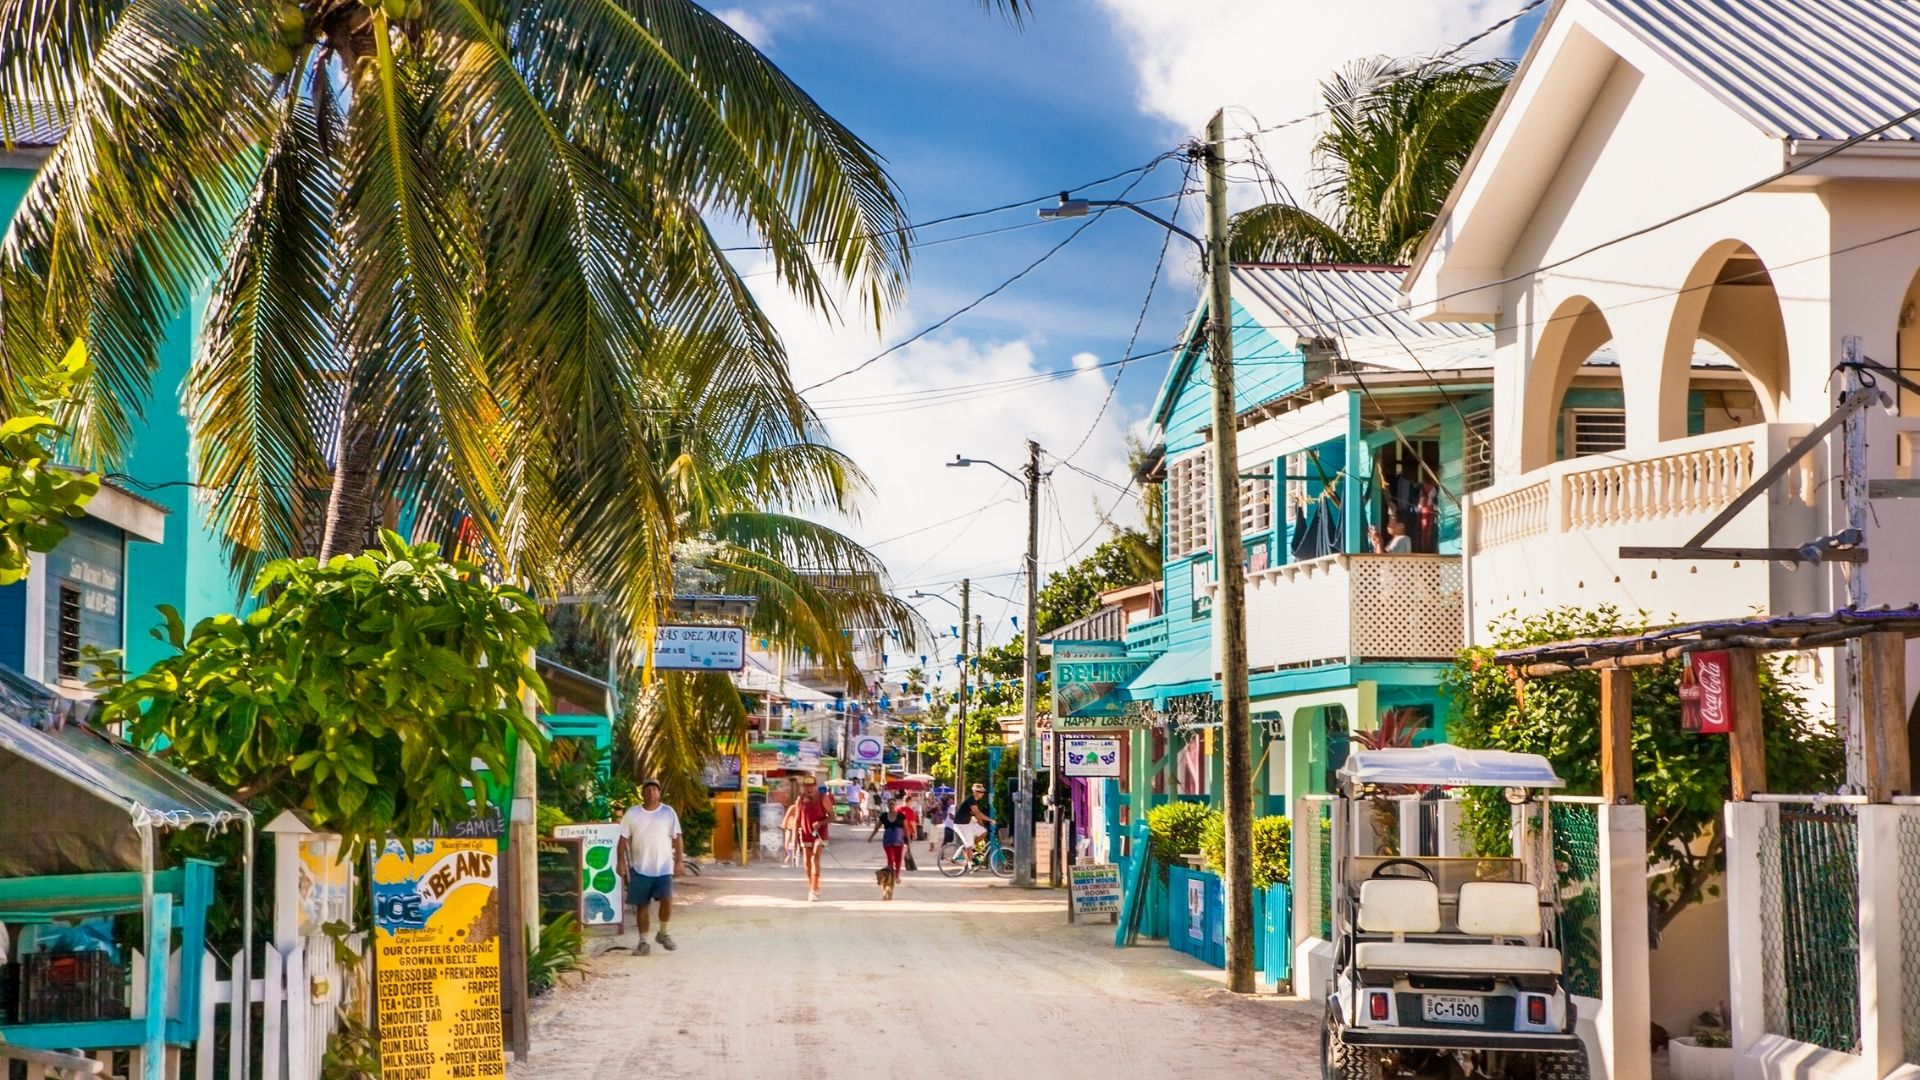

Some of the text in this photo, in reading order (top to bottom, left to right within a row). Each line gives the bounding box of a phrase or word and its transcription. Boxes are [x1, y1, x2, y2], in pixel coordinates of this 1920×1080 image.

[658, 631, 739, 644] SAS DEL MAR
[1064, 716, 1098, 727] HAPPY
[456, 819, 505, 837] SAMPLE
[428, 851, 494, 900] BEANS
[377, 893, 425, 926] ICE
[383, 944, 493, 956] OUR COFFEE IS ORGANIC
[400, 955, 477, 966] GROWN IN BELIZE
[380, 968, 437, 982] ESPRESSO BAR
[445, 967, 498, 979] FRENCH PRESS
[380, 982, 433, 997] ICED COFFEE
[468, 981, 498, 994] FRAPPE
[380, 995, 440, 1010] TEA ICED TEA
[480, 995, 499, 1006] CHAI
[381, 1009, 442, 1025] SMOOTHIE BAR
[461, 1008, 499, 1021] SLUSHIES
[1435, 1003, 1479, 1017] C-1500
[381, 1024, 428, 1039] SHAVED ICE
[454, 1022, 500, 1036] 30 FLAVORS
[382, 1039, 428, 1054] RUM BALLS
[454, 1036, 500, 1050] CHOCOLATES
[383, 1052, 435, 1068] MILK SHAKES
[445, 1049, 501, 1064] PROTEIN SHAKE
[384, 1067, 431, 1080] MINI DONUT
[453, 1063, 503, 1078] MADE FRESH
